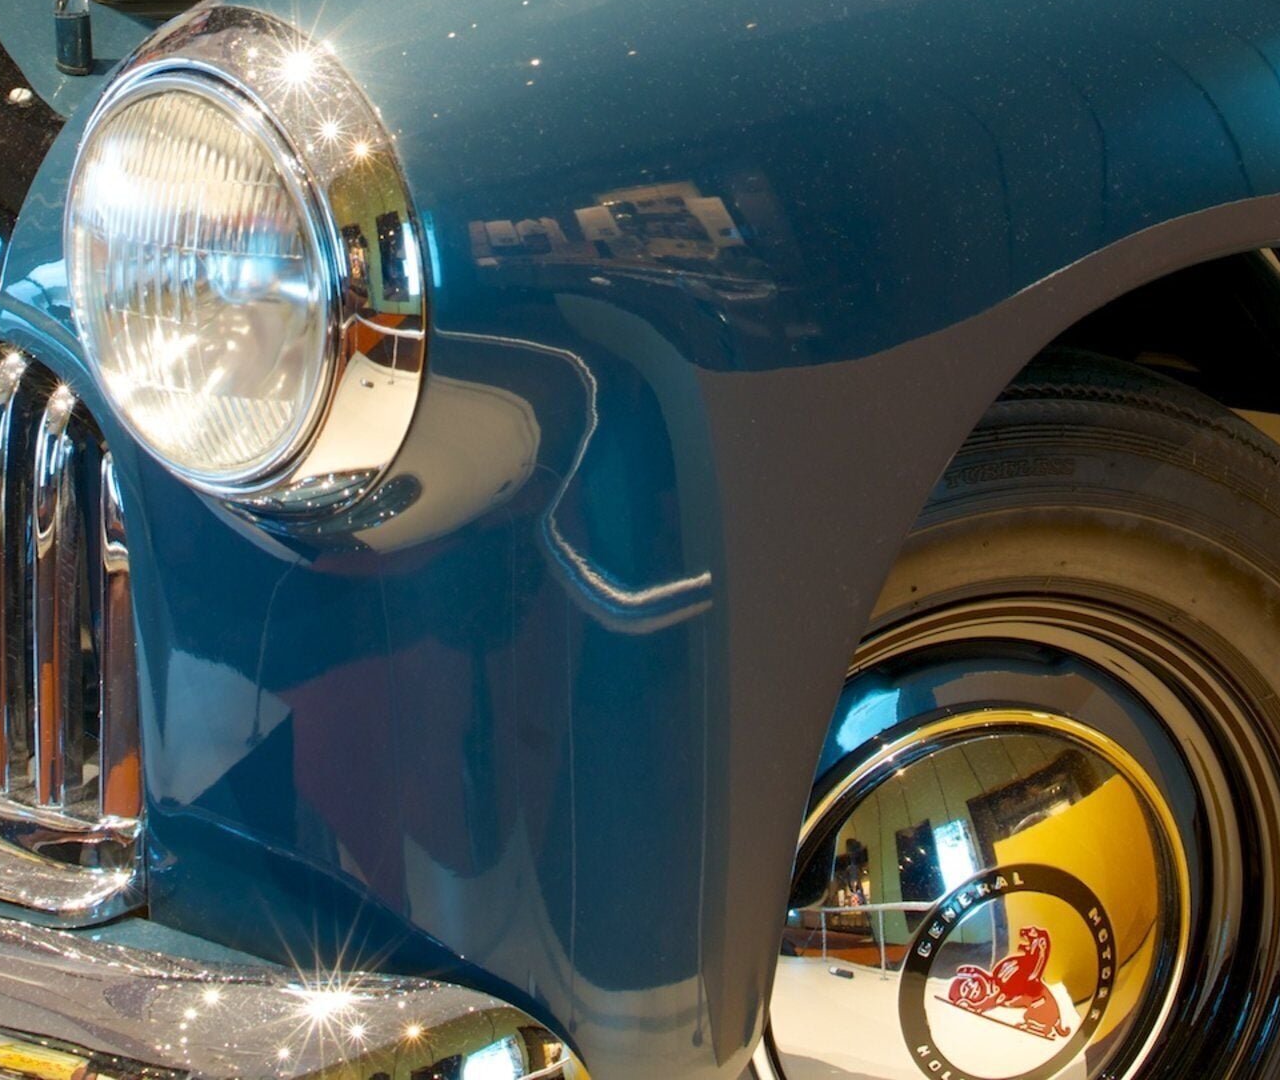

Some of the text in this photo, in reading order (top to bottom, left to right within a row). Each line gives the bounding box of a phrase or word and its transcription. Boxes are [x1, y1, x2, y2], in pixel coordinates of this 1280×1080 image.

[944, 457, 1075, 489] TUBELESS
[917, 871, 1111, 1020] GENERAL MOTORS
